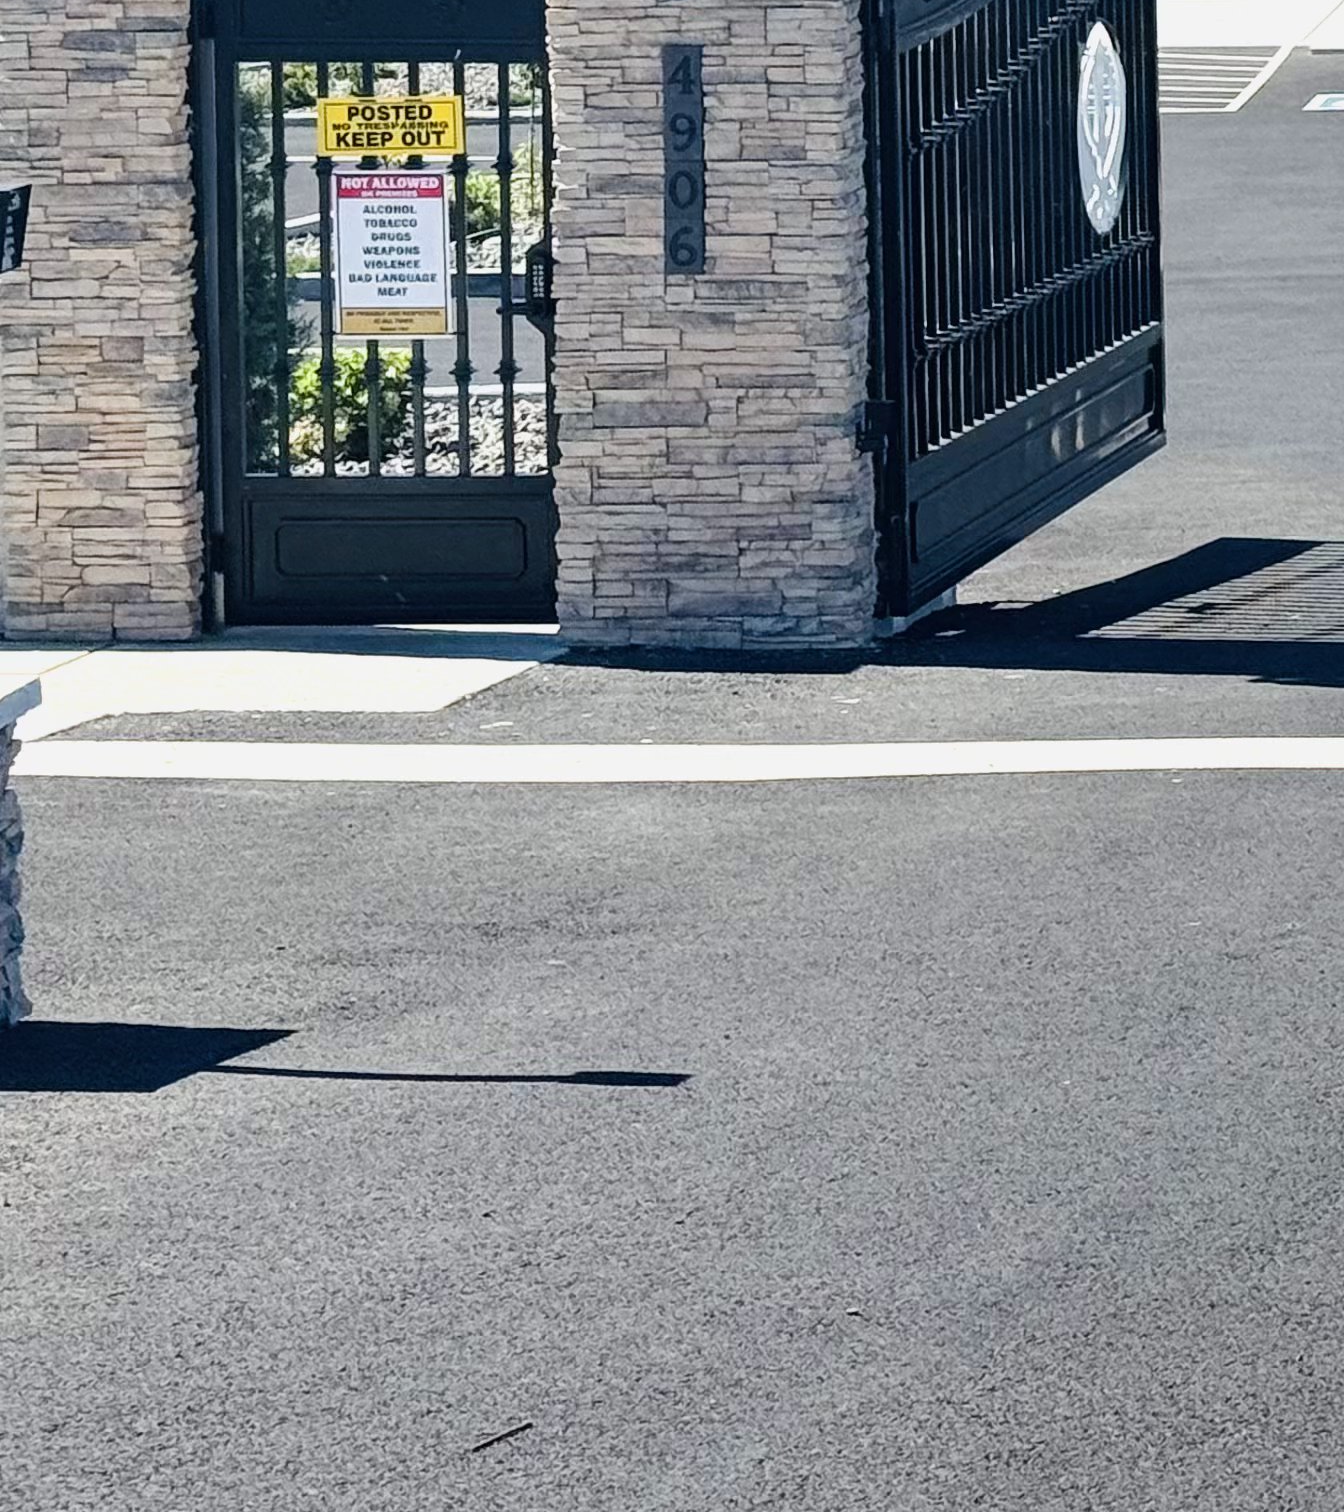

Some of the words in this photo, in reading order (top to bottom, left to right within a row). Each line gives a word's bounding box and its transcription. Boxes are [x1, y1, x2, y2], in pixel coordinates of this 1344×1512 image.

[347, 105, 433, 121] POSTED
[332, 122, 351, 131] NO
[355, 120, 450, 131] TRESPASSING
[335, 131, 394, 148] KEEP
[401, 130, 446, 147] OUT
[668, 55, 699, 267] 4906
[340, 177, 371, 189] NOT
[371, 176, 440, 189] ALLOWED
[362, 204, 417, 215] ALCOHOL
[363, 218, 418, 228] TOBACCO
[371, 232, 412, 242] DRUGS
[362, 246, 421, 256] WEAPONS
[363, 259, 422, 270] VIOLENCE
[348, 273, 373, 283] BAD
[375, 273, 438, 283] LANGUAGE
[377, 287, 409, 297] MEAT
